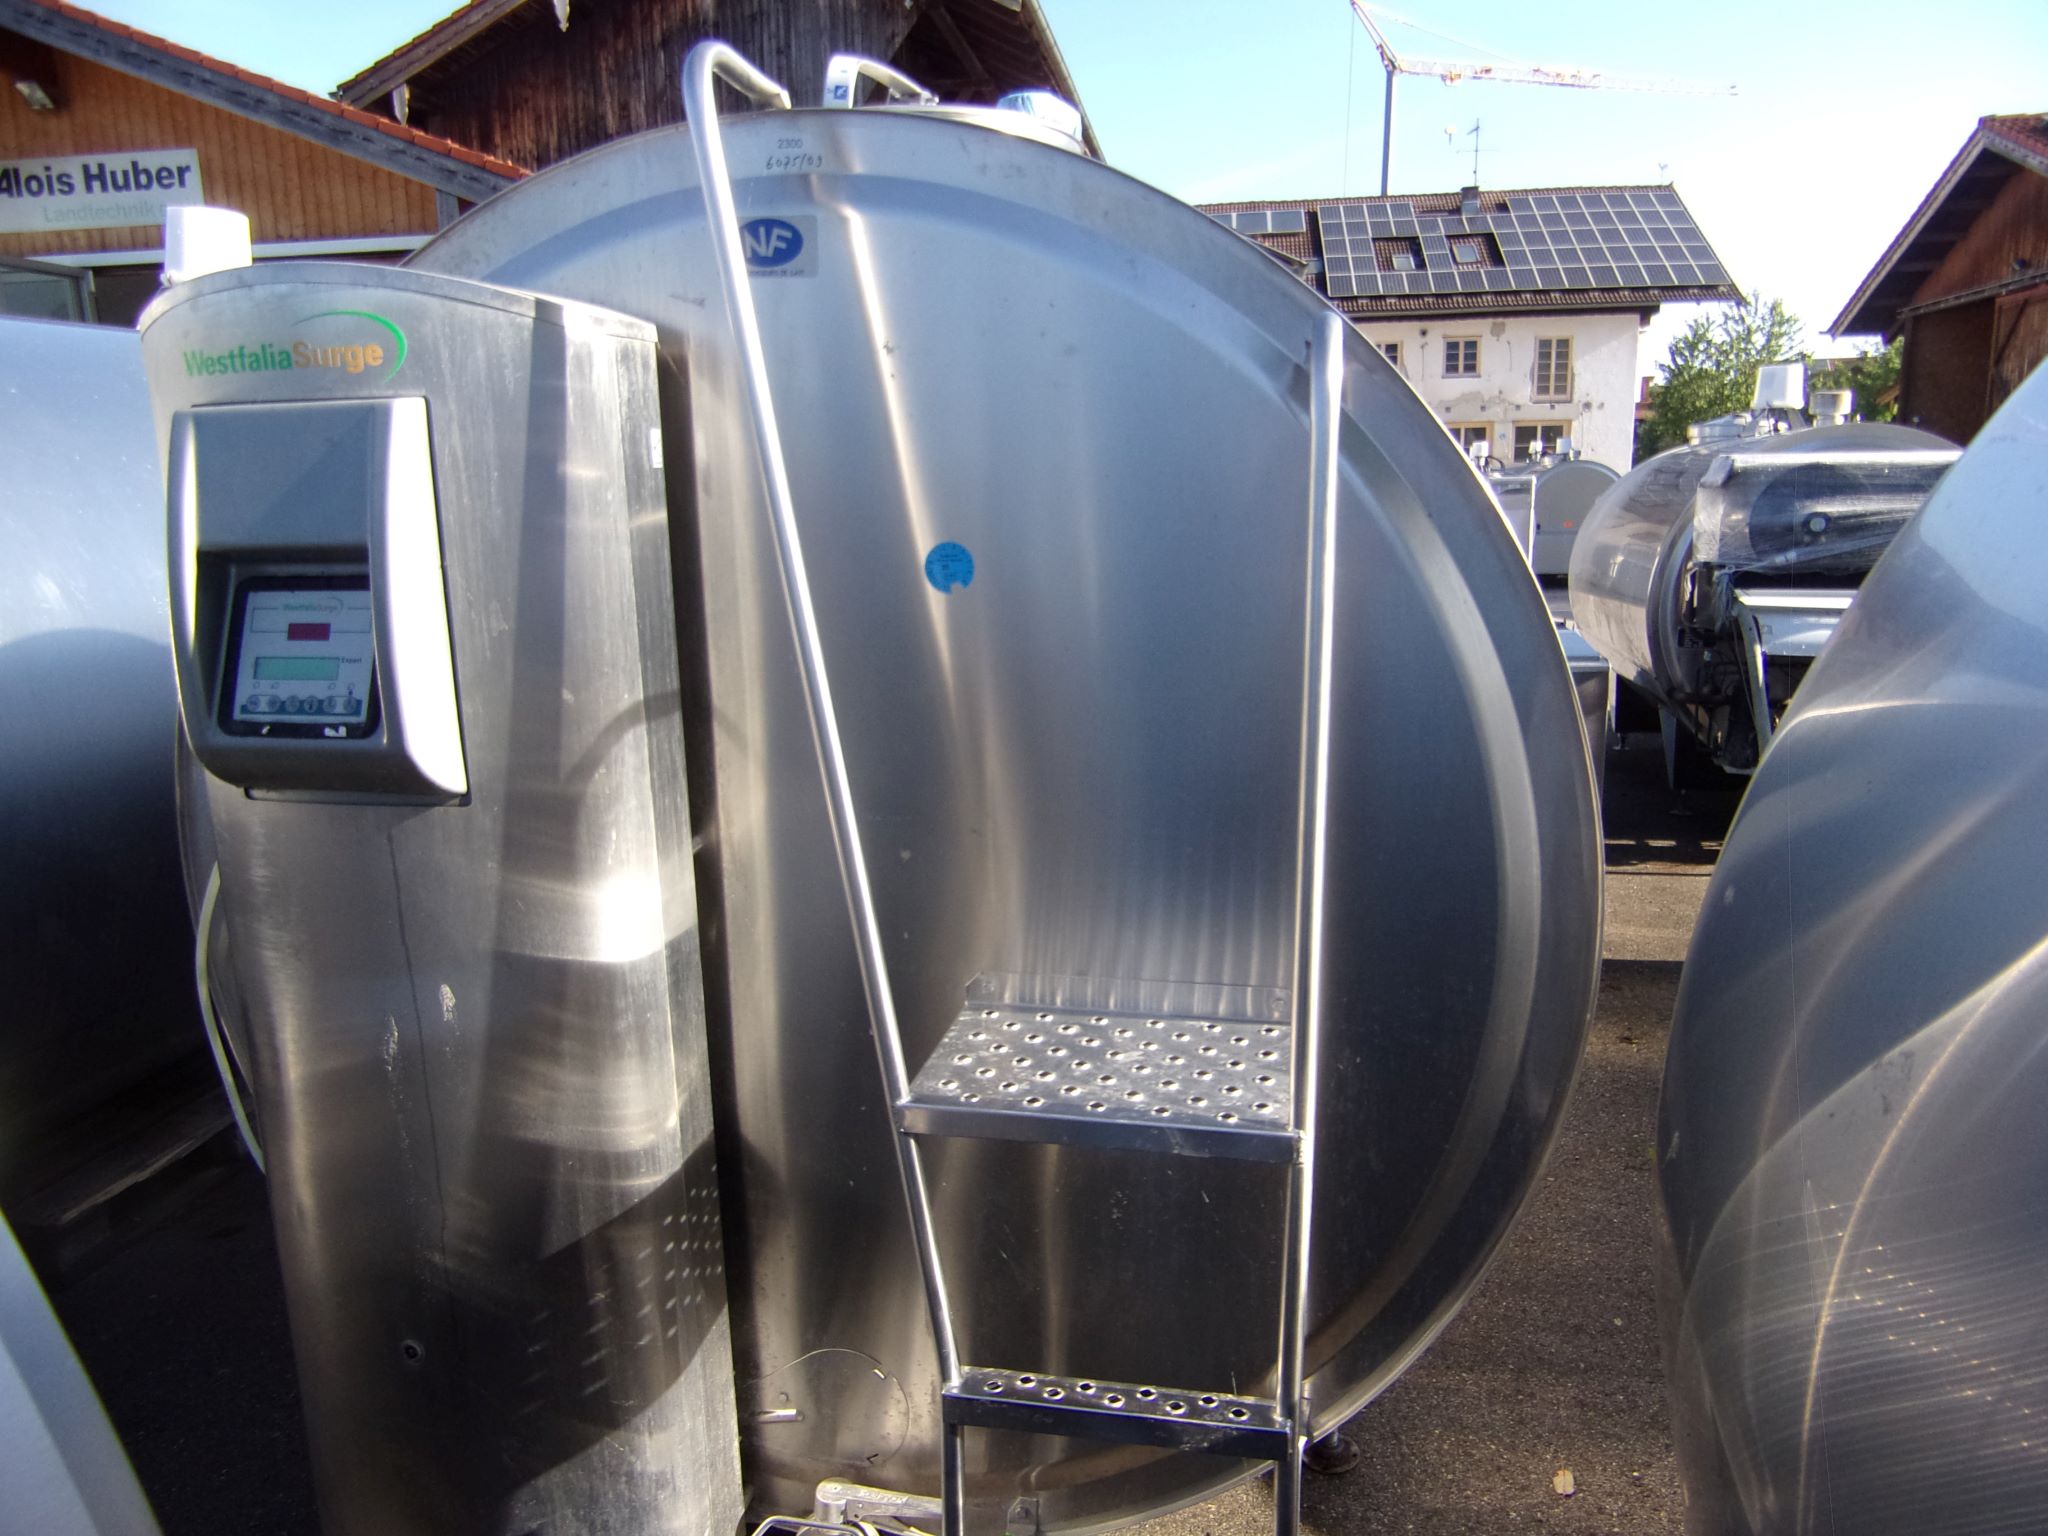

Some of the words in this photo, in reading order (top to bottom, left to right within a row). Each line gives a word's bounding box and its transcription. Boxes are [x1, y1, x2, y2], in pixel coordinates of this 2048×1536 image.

[0, 166, 75, 198] Alois
[82, 160, 192, 194] Huber
[743, 226, 792, 259] NF
[183, 340, 384, 376] WestfaliaSurge
